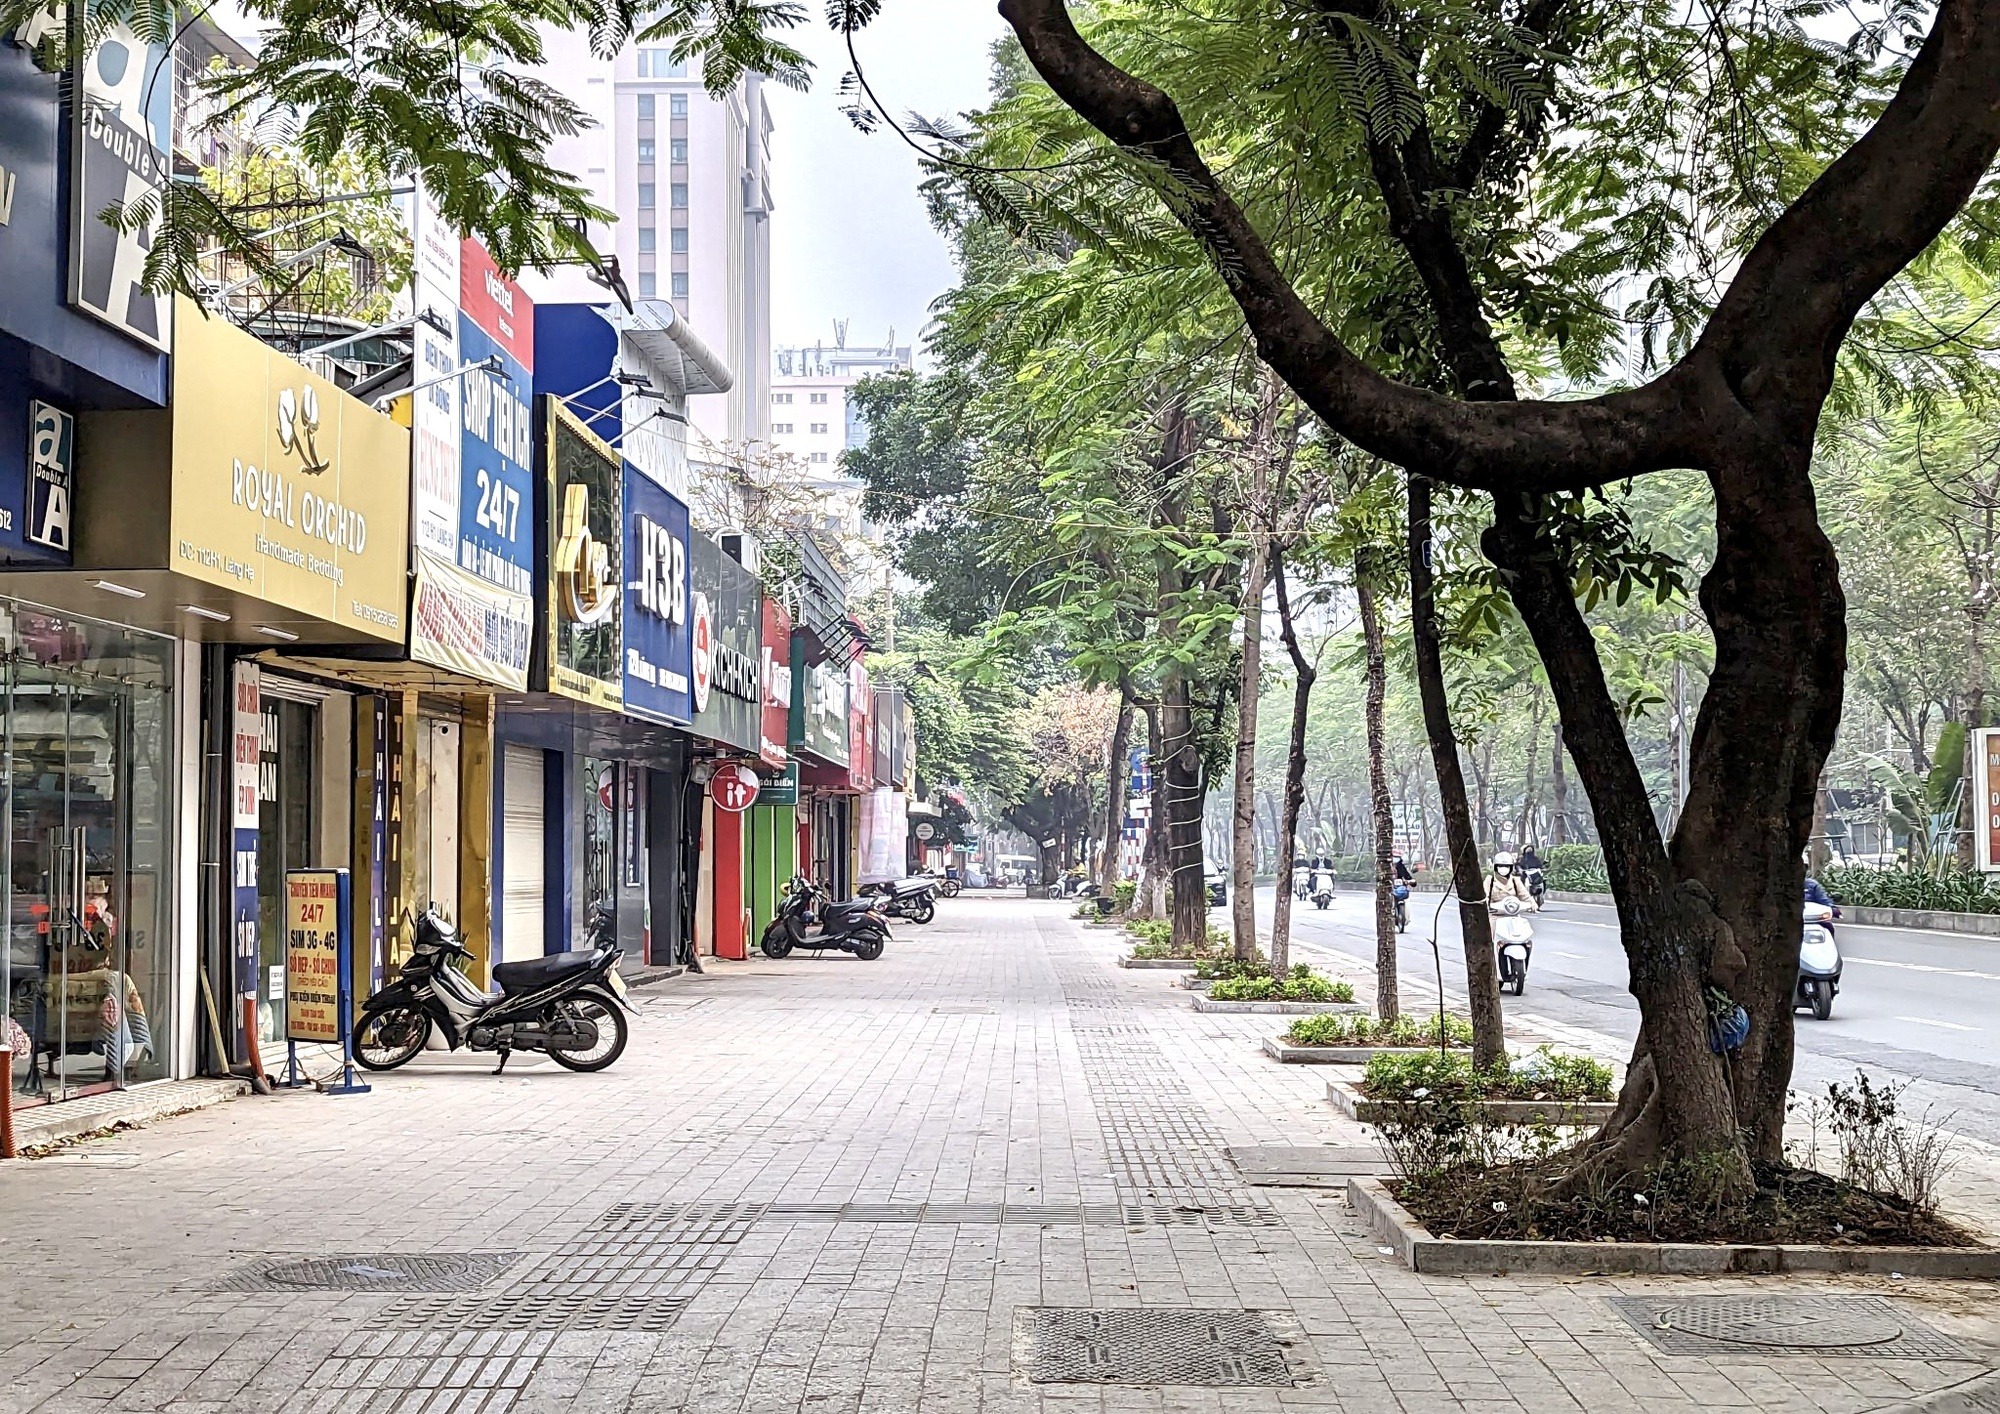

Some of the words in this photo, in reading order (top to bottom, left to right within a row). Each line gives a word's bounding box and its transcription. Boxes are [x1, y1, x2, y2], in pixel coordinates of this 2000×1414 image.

[90, 104, 149, 176] Double
[155, 157, 168, 191] A
[464, 358, 491, 443] SHOP
[515, 385, 530, 473] ÍCH
[36, 464, 60, 484] Double
[62, 474, 69, 489] A
[232, 457, 295, 528] ROYAL
[302, 491, 367, 555] ORCHID
[476, 468, 520, 543] 24/7
[41, 483, 69, 549] A
[255, 532, 305, 568] Handmade
[307, 553, 344, 587] Bedding
[640, 514, 686, 626] H3B
[237, 851, 247, 887] SIM
[290, 929, 305, 948] SIM
[306, 930, 318, 949] 3G
[324, 931, 335, 951] 4G
[301, 903, 324, 923] 24/7
